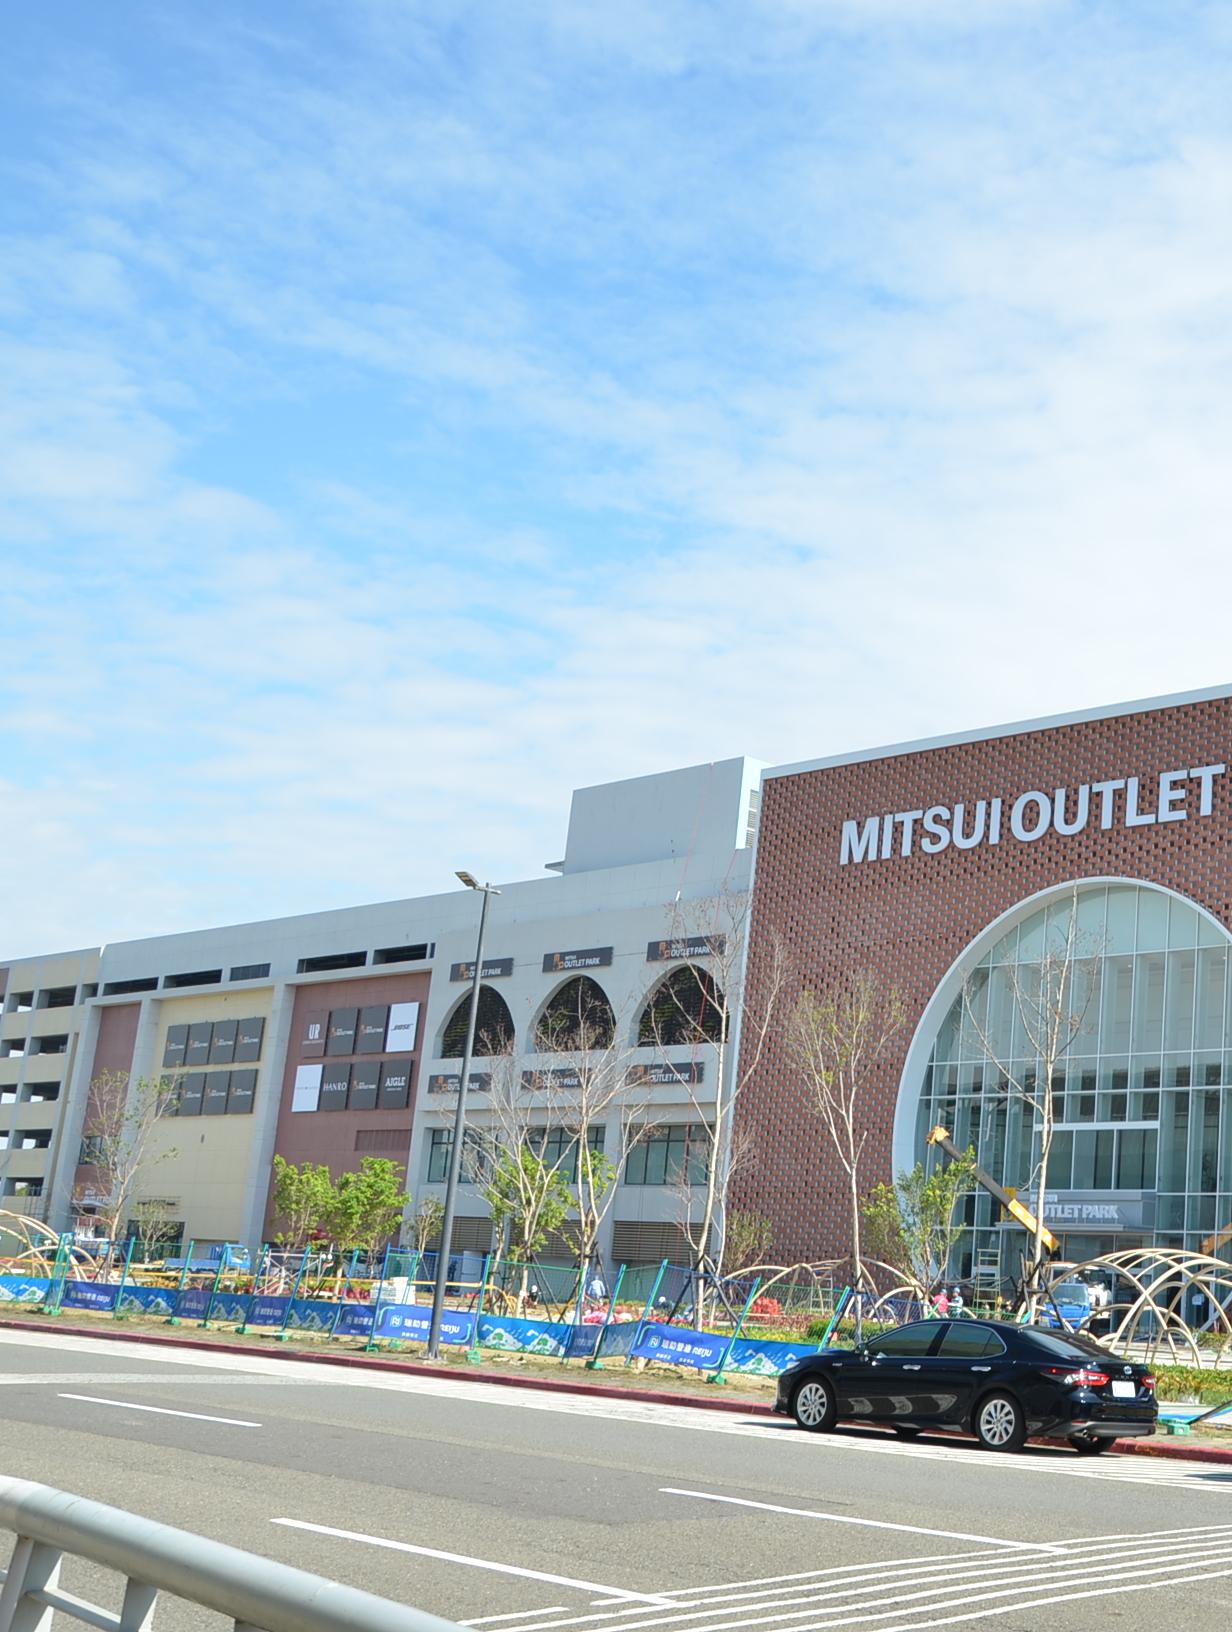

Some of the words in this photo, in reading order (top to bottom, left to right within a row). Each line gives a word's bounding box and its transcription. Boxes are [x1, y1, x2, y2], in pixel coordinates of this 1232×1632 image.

[840, 798, 1000, 865] MITSUI
[1010, 764, 1226, 842] OUTLET
[309, 1024, 320, 1039] UR
[323, 1082, 347, 1092] HANRO
[385, 1076, 406, 1086] AIGLE
[1082, 1205, 1118, 1218] PARK
